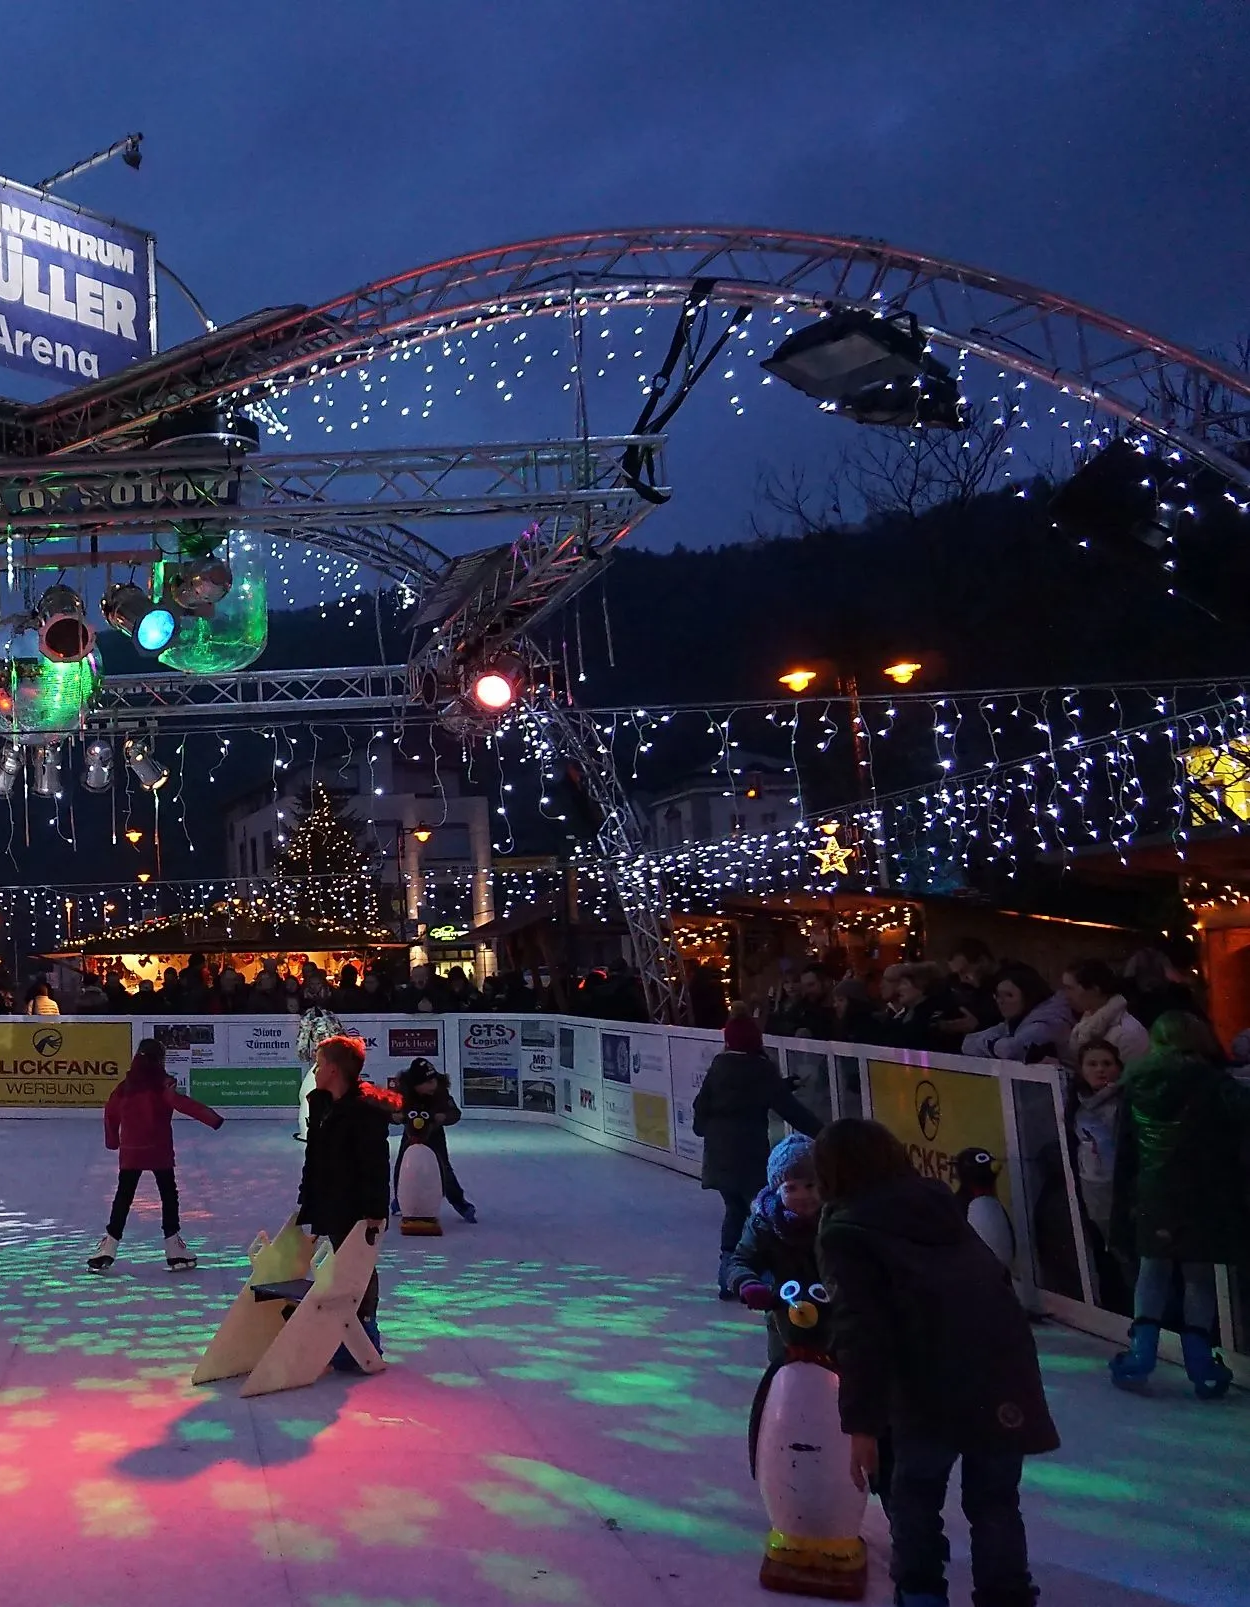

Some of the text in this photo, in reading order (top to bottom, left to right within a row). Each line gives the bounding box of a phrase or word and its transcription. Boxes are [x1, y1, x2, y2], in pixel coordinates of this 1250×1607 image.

[469, 1024, 506, 1037] GTS
[391, 1039, 436, 1048] Park Hotel
[472, 1037, 510, 1046] Logistik
[6, 1082, 95, 1095] WERBUNG
